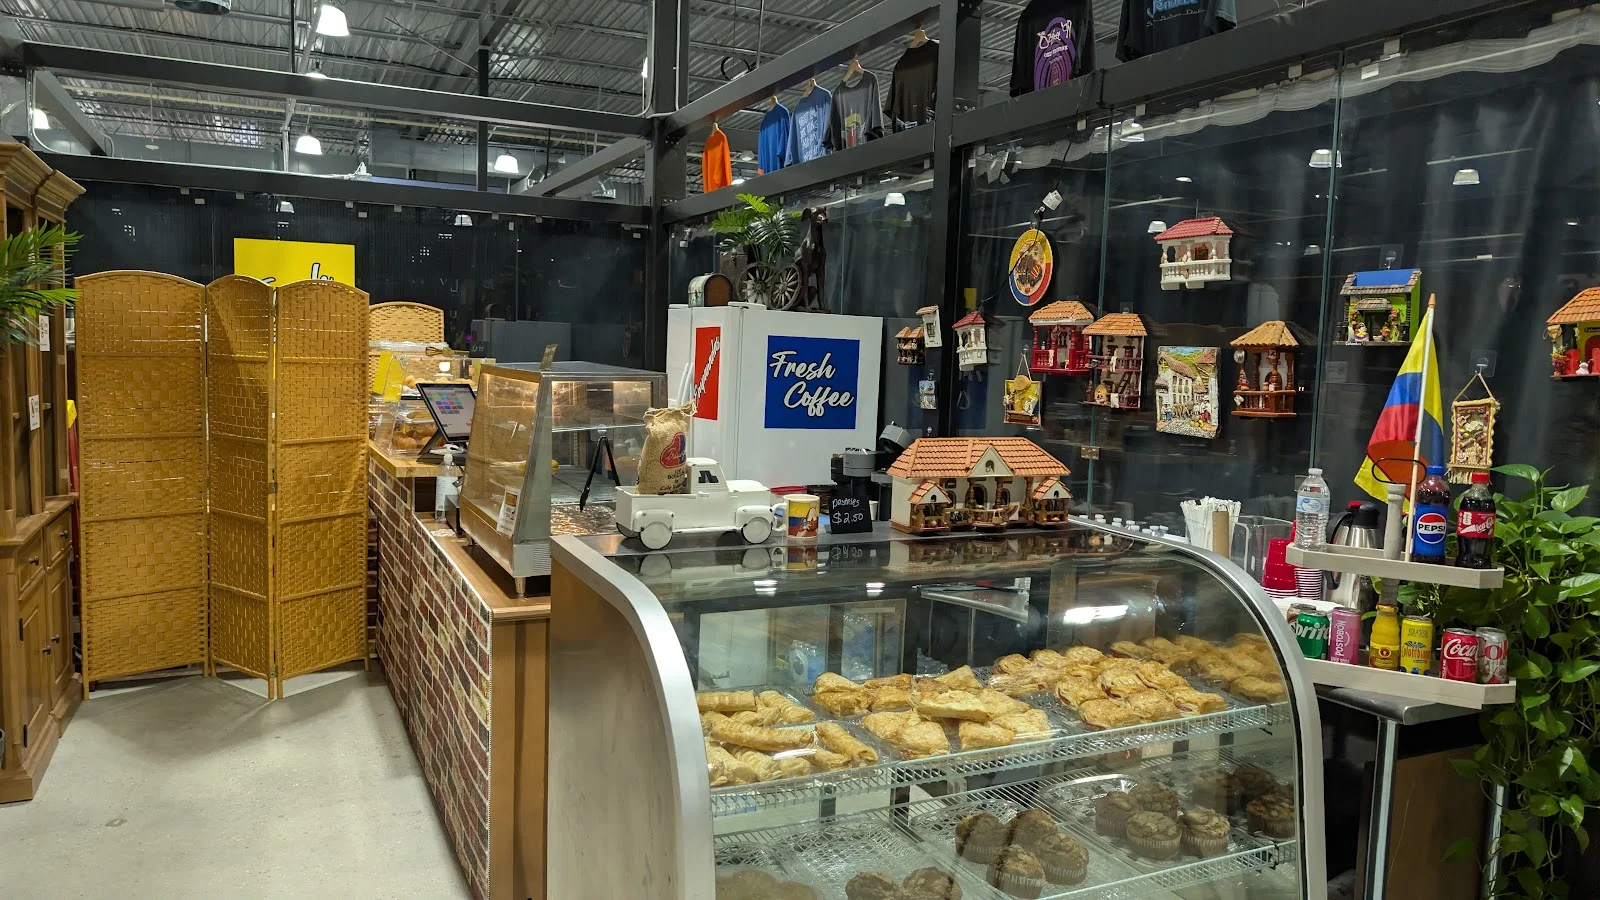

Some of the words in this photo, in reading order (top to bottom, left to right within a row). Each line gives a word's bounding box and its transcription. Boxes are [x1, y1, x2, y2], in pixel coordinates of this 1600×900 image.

[769, 350, 836, 380] Fresh
[783, 380, 855, 417] Coffee
[1418, 524, 1446, 533] PEPSI
